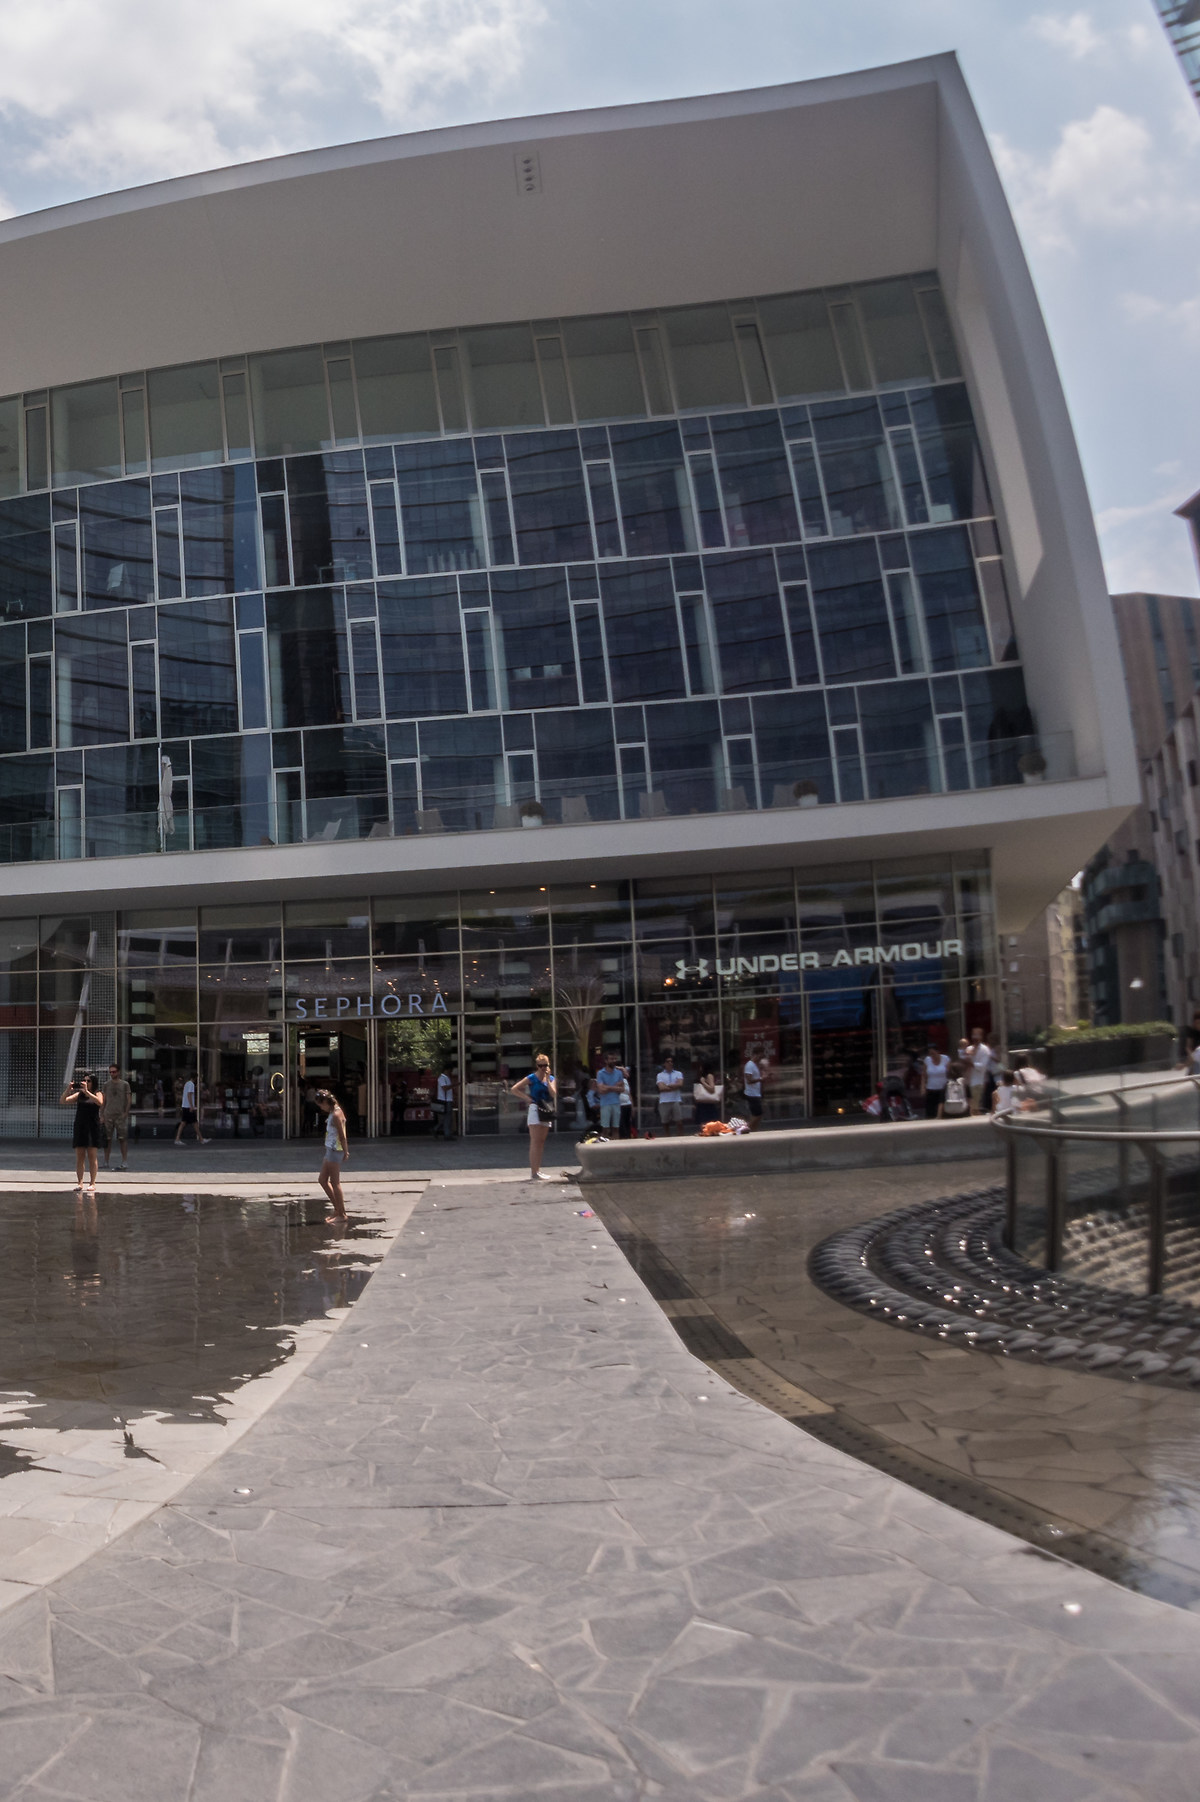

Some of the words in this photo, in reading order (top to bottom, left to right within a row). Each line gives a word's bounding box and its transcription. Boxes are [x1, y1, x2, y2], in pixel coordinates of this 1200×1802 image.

[715, 952, 819, 975] UNDER
[831, 939, 964, 967] ARMOUR
[295, 992, 448, 1019] SEPHORA
